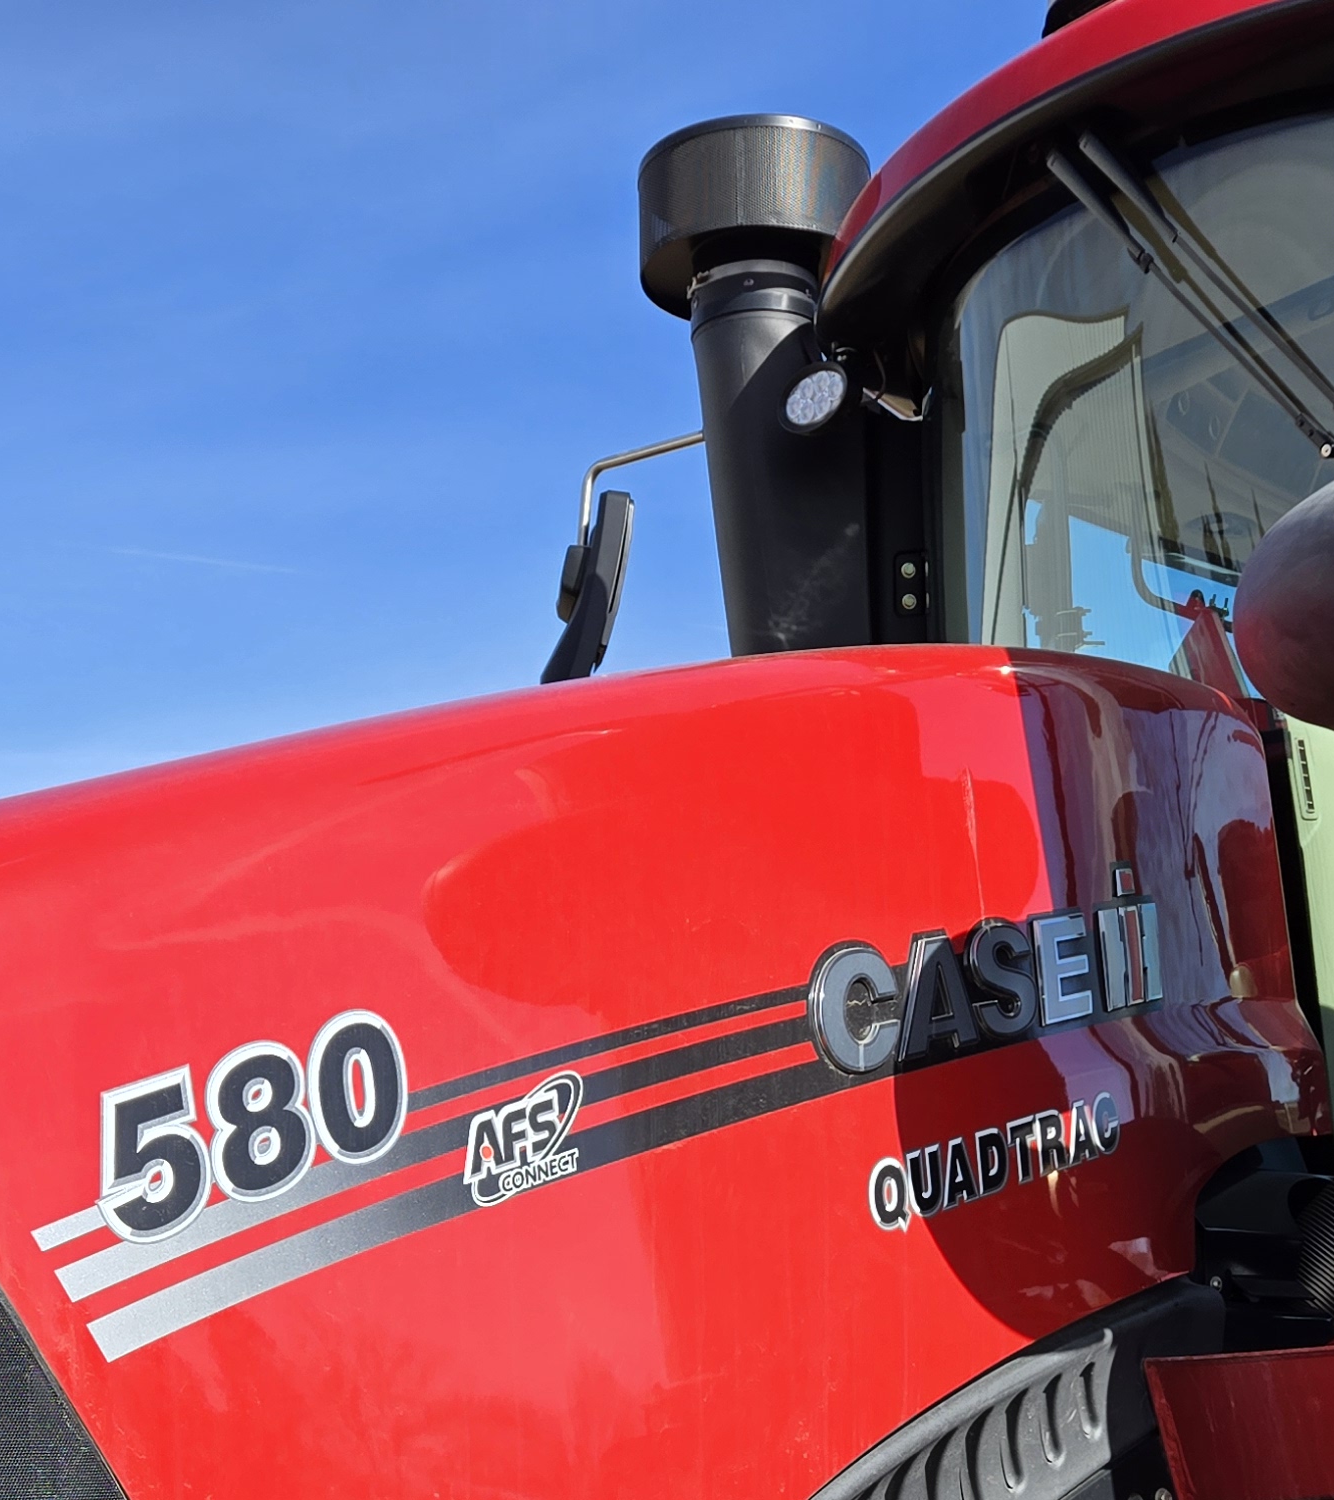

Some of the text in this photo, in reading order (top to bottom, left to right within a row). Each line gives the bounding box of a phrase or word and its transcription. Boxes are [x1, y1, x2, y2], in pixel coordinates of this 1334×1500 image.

[808, 913, 1094, 1074] CASE
[97, 1009, 408, 1244] 580
[466, 1092, 559, 1182] AFS
[501, 1151, 578, 1193] CONNECT
[869, 1092, 1121, 1232] QUADTRAC
